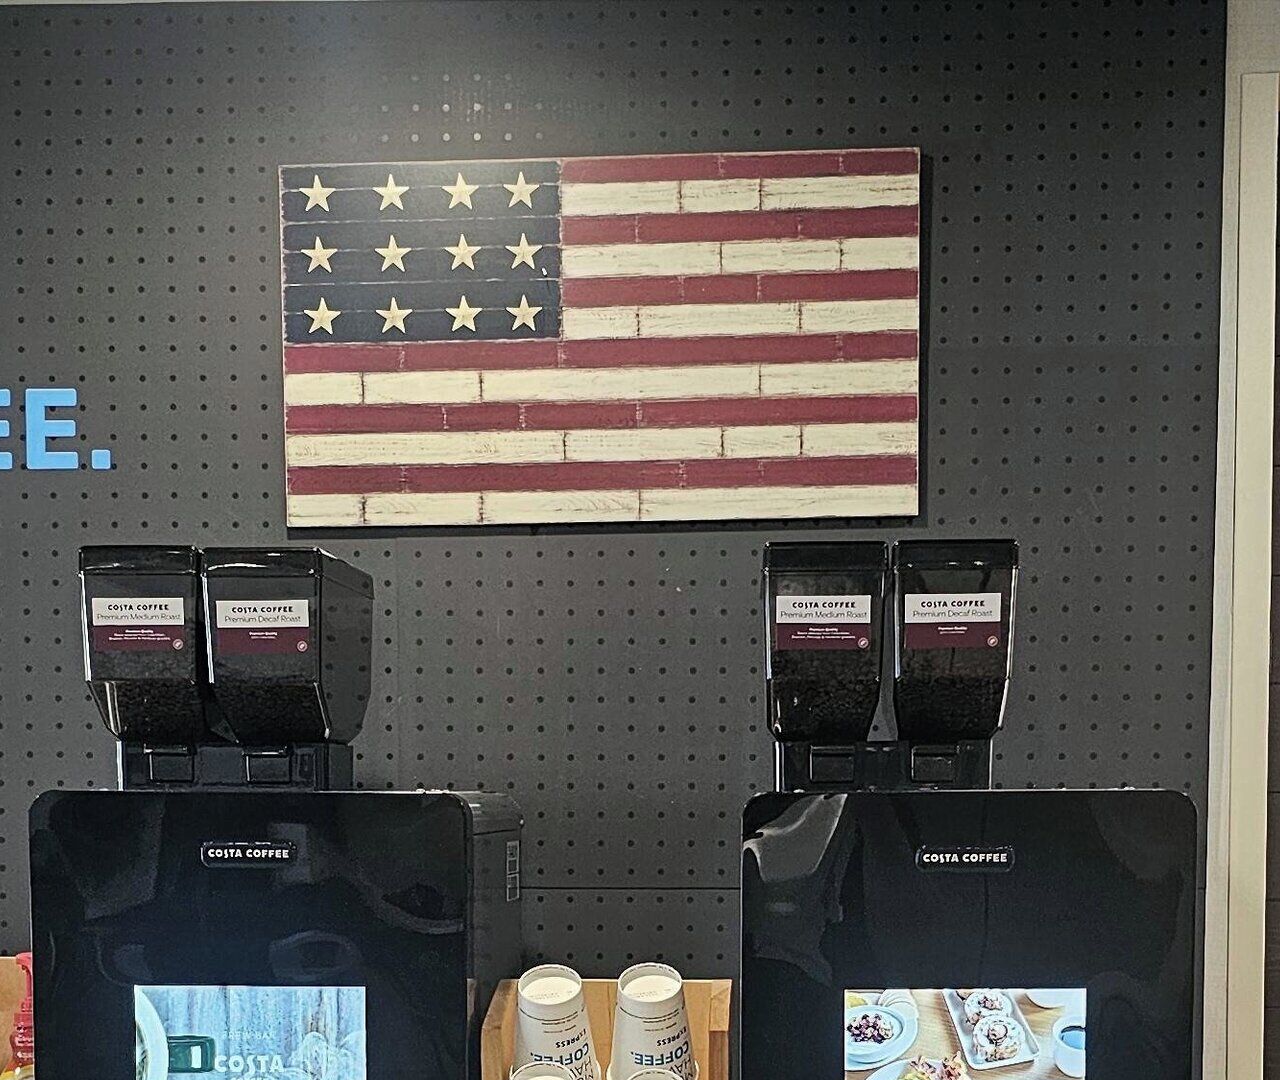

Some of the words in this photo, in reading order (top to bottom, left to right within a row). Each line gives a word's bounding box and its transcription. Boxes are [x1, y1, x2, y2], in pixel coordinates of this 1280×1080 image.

[207, 849, 243, 858] COSTA
[246, 849, 289, 858] COFFEE
[923, 853, 959, 863] COSTA
[962, 853, 1008, 862] COFFEE
[631, 1040, 689, 1066] COFFEE.
[214, 1054, 285, 1078] COSTA
